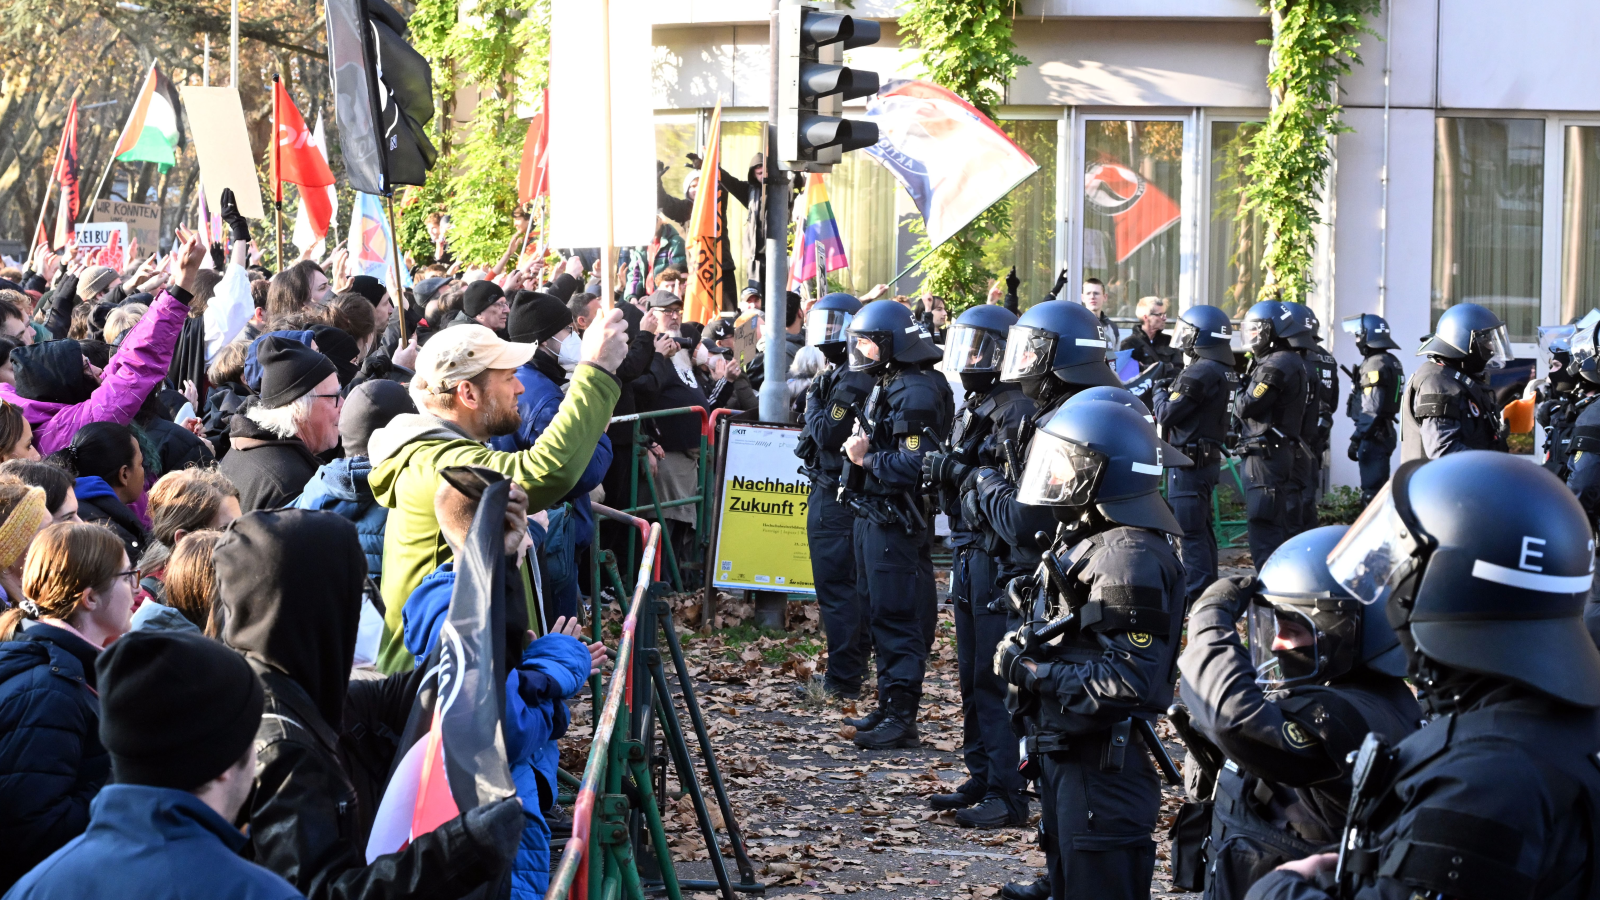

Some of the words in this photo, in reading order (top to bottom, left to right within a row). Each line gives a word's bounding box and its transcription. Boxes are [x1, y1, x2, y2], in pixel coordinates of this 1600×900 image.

[96, 201, 111, 214] WIR
[1220, 325, 1227, 335] E
[732, 475, 811, 494] Nachhalti
[729, 496, 794, 515] Zukunft
[799, 502, 807, 515] ?
[1518, 535, 1547, 572] E
